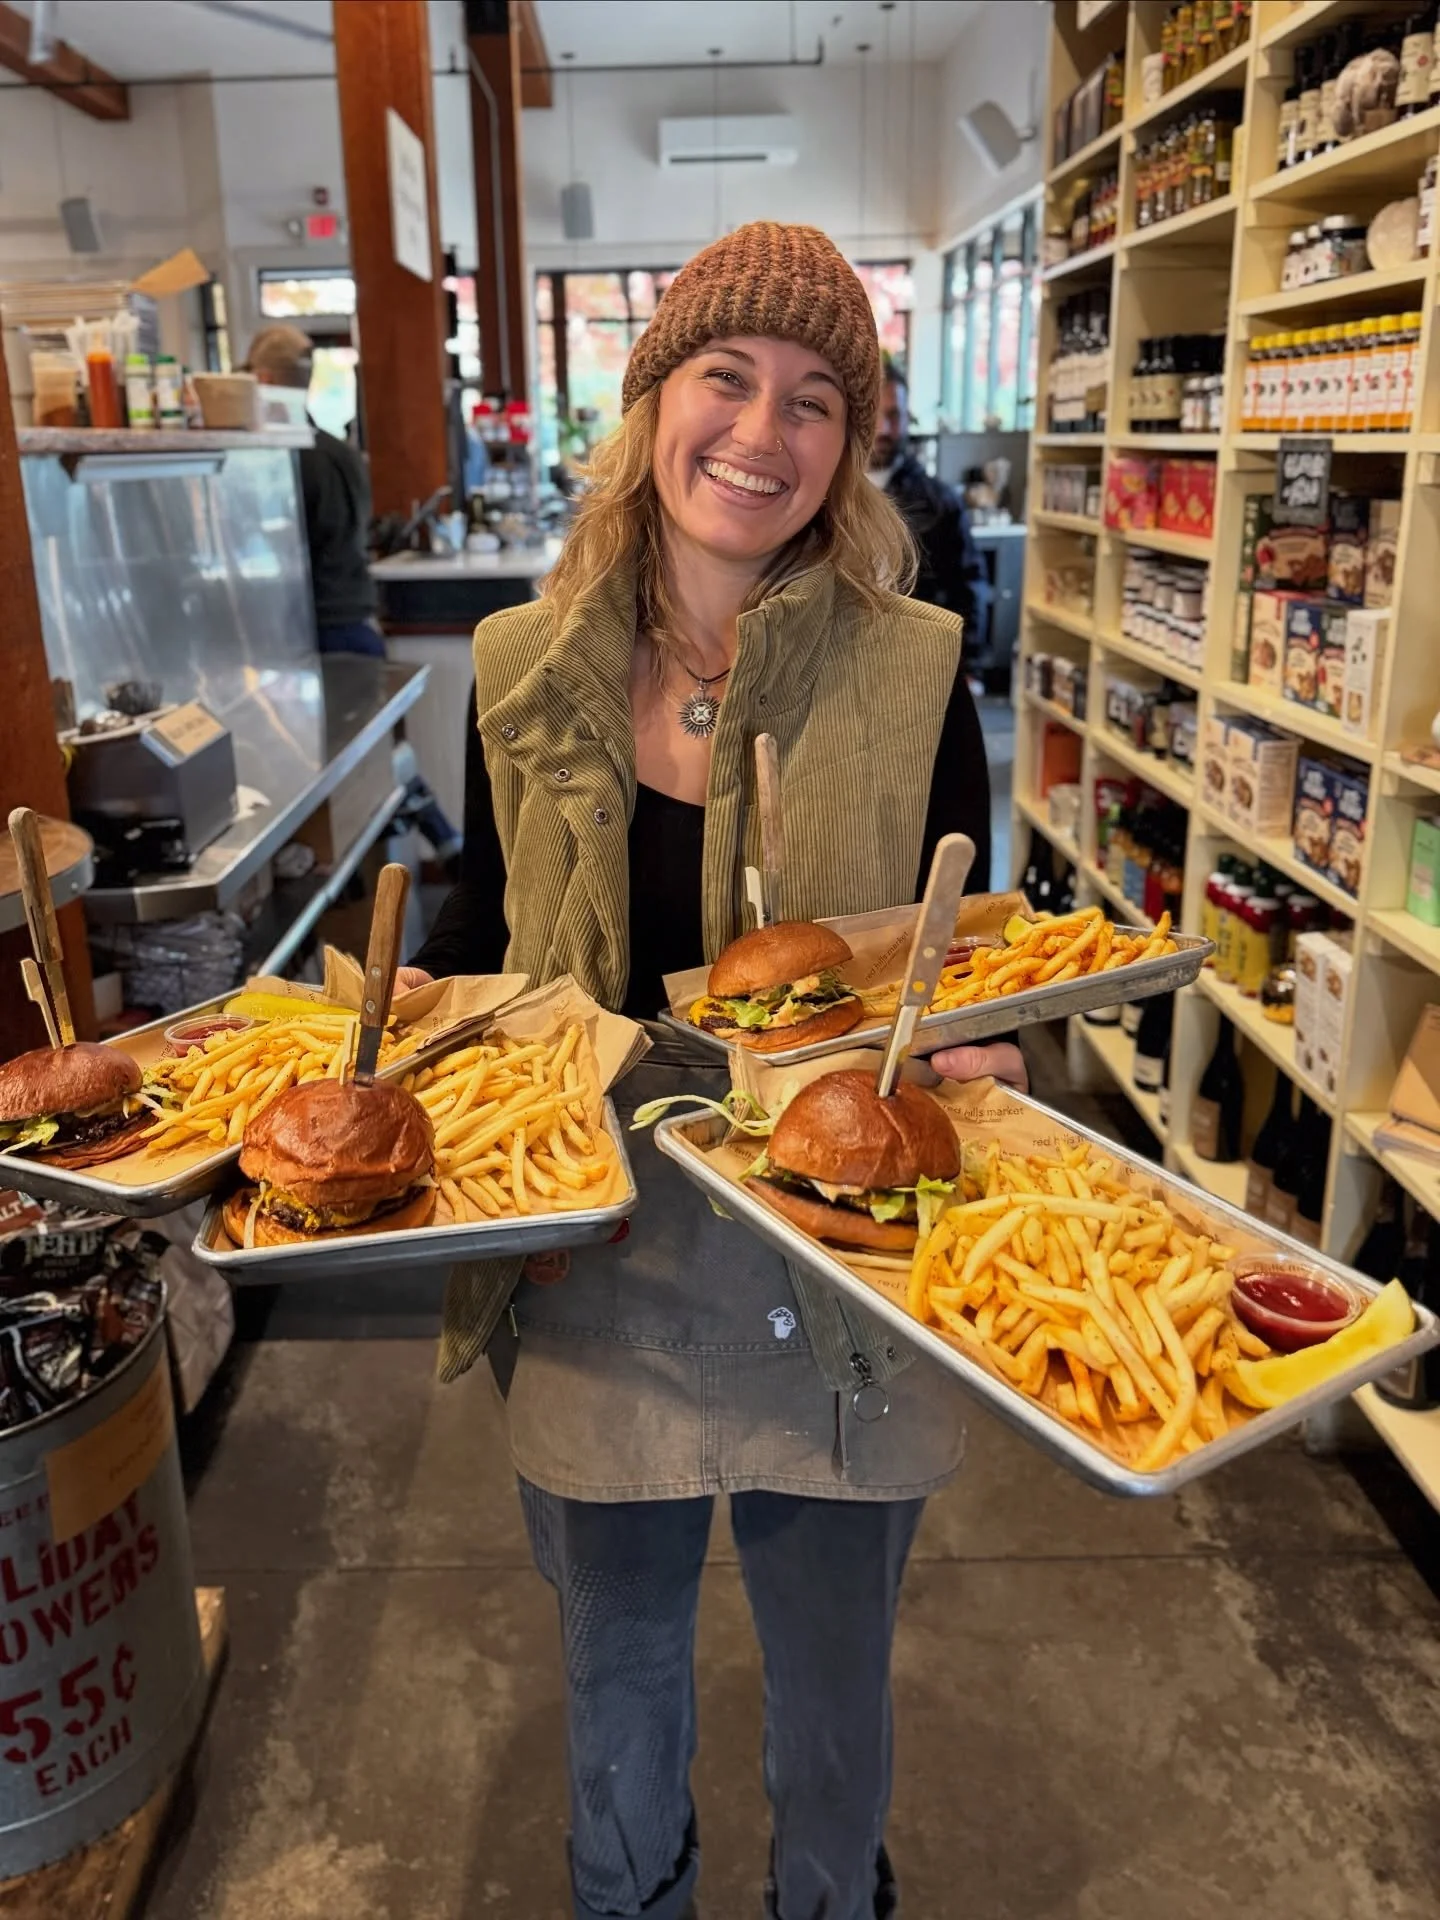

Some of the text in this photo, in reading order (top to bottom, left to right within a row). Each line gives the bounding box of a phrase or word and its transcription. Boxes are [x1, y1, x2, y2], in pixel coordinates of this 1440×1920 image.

[887, 931, 909, 956] market
[986, 1105, 1024, 1116] market
[1032, 1135, 1051, 1147] red
[878, 1279, 900, 1289] red
[35, 1716, 132, 1796] EACH
